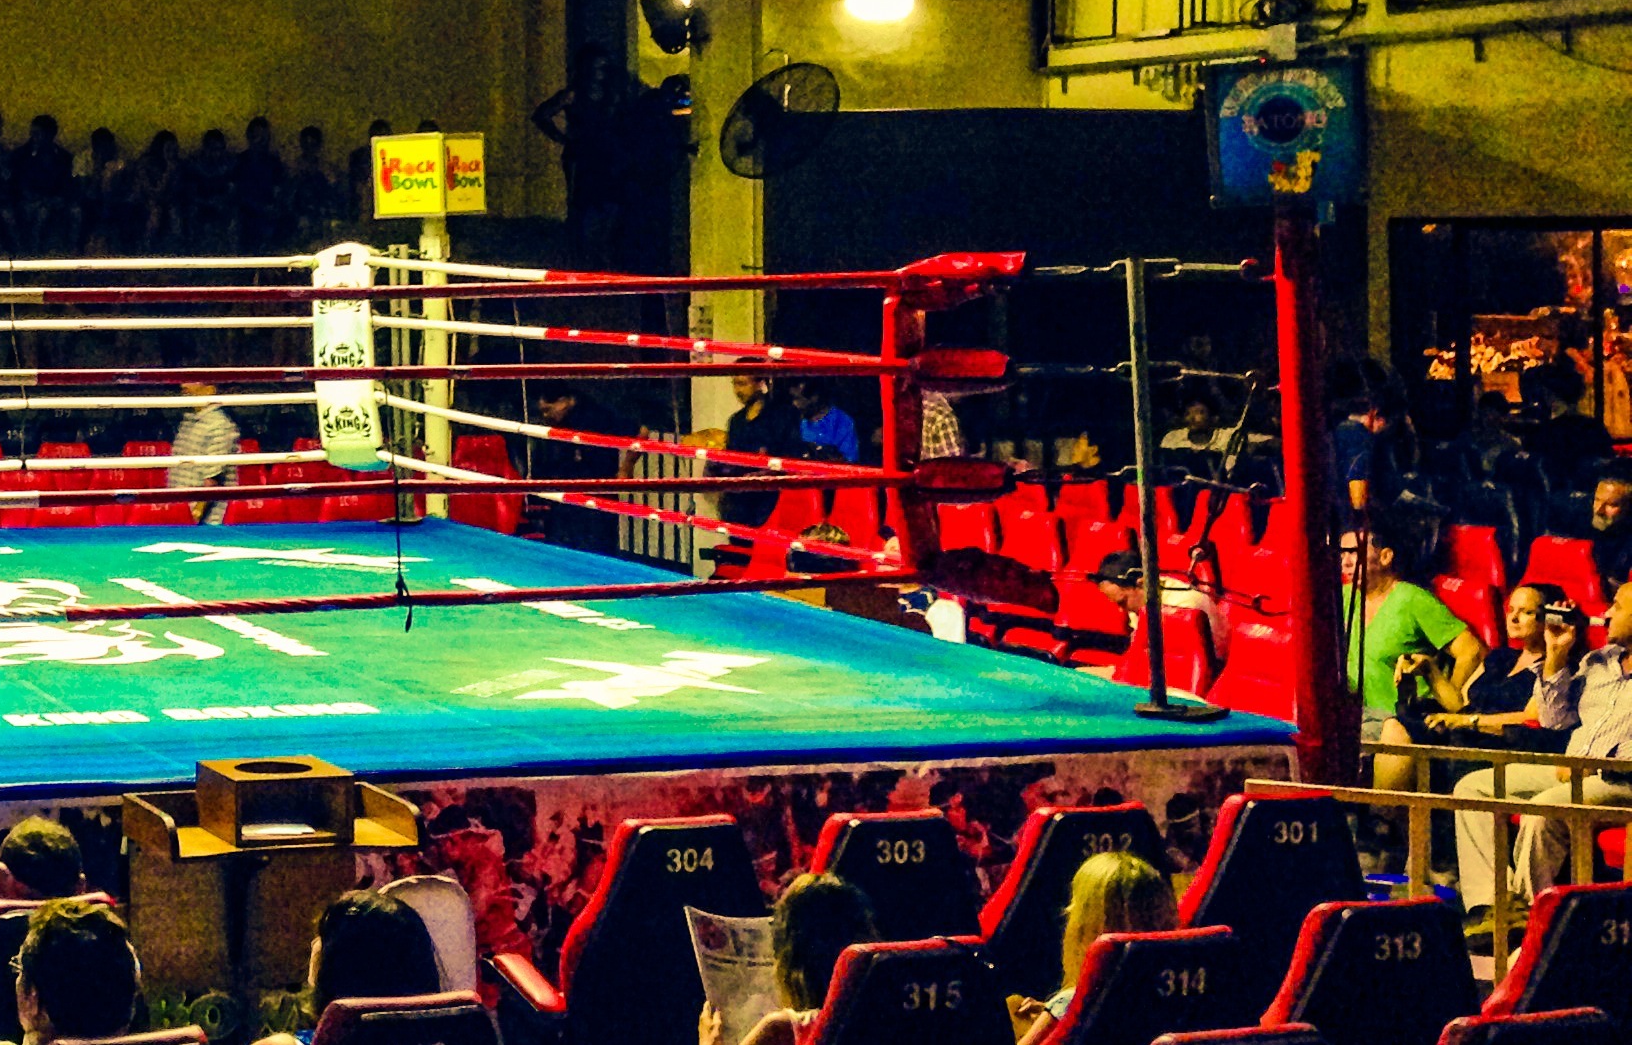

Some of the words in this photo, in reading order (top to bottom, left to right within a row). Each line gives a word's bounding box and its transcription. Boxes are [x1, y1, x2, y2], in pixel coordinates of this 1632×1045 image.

[330, 353, 355, 368] KING
[335, 416, 361, 431] KING
[2, 709, 150, 727] KING
[160, 701, 381, 722] BOXING
[1082, 832, 1132, 856] 302
[1274, 820, 1318, 844] 301
[666, 847, 714, 873] 304
[876, 839, 926, 864] 303
[1375, 931, 1422, 961] 313
[1158, 967, 1206, 997] 314
[903, 980, 963, 1011] 315
